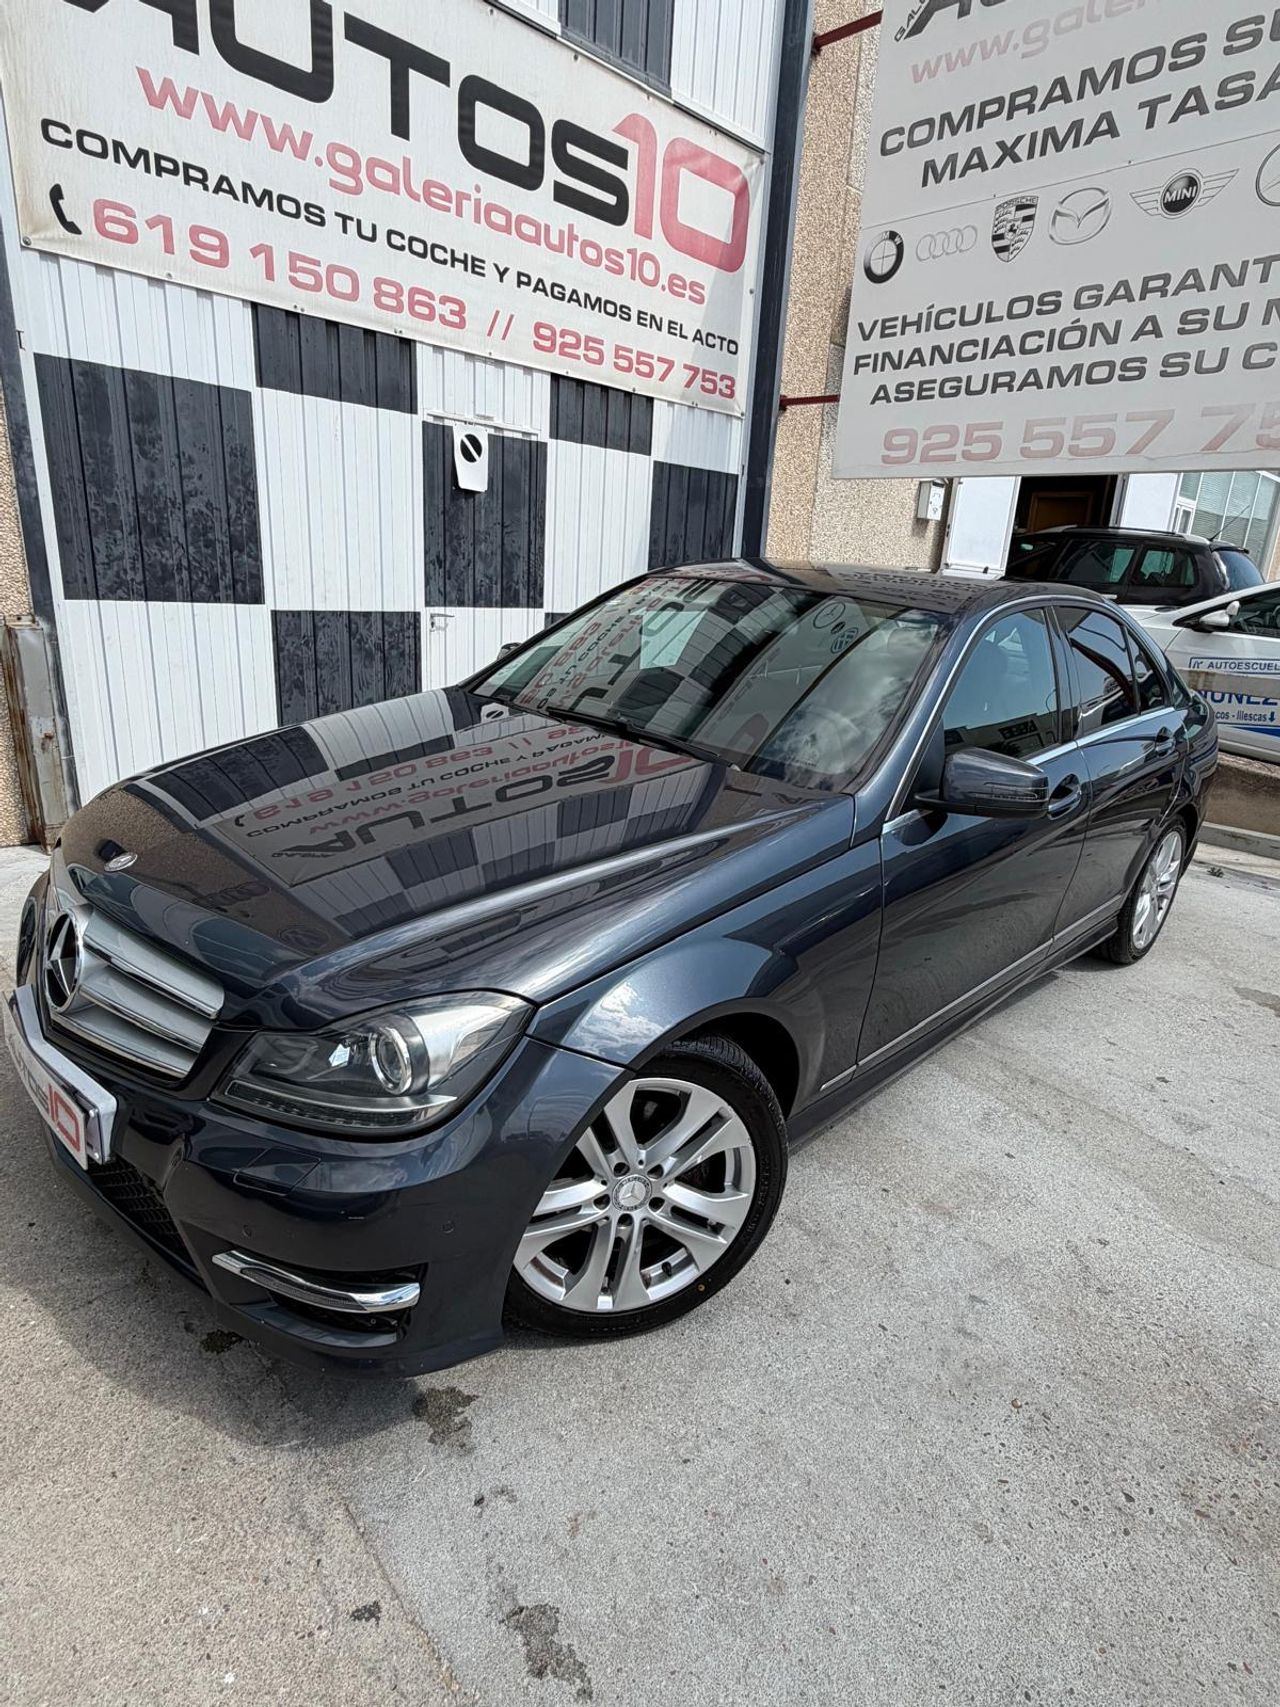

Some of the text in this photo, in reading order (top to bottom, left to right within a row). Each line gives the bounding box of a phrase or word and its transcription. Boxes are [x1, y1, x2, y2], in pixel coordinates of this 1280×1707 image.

[880, 8, 1280, 156] COMPRAMOS S
[62, 0, 750, 273] UTOS10
[921, 110, 1120, 188] MAXIMA
[136, 66, 705, 305] www.galeriaautos10.es
[1164, 185, 1198, 203] MINI
[41, 118, 739, 355] COMPRAMOS TU COCHE Y PAGAMOS EN EL ACTO
[94, 199, 230, 269] 619
[250, 243, 360, 302] 150
[373, 277, 467, 330] 863
[533, 322, 605, 366] 925
[613, 344, 675, 382] 557
[682, 363, 736, 398] 753
[857, 290, 1063, 342] VEHÍCULOS
[853, 318, 1121, 375] FINANCIACIÓN
[1131, 314, 1163, 342] A
[1177, 302, 1249, 336] SU
[870, 356, 1146, 405] ASEGURAMOS
[1159, 346, 1230, 378] SU
[881, 422, 1004, 465] 925
[1019, 410, 1175, 459] 557
[1236, 710, 1268, 721] Illescas
